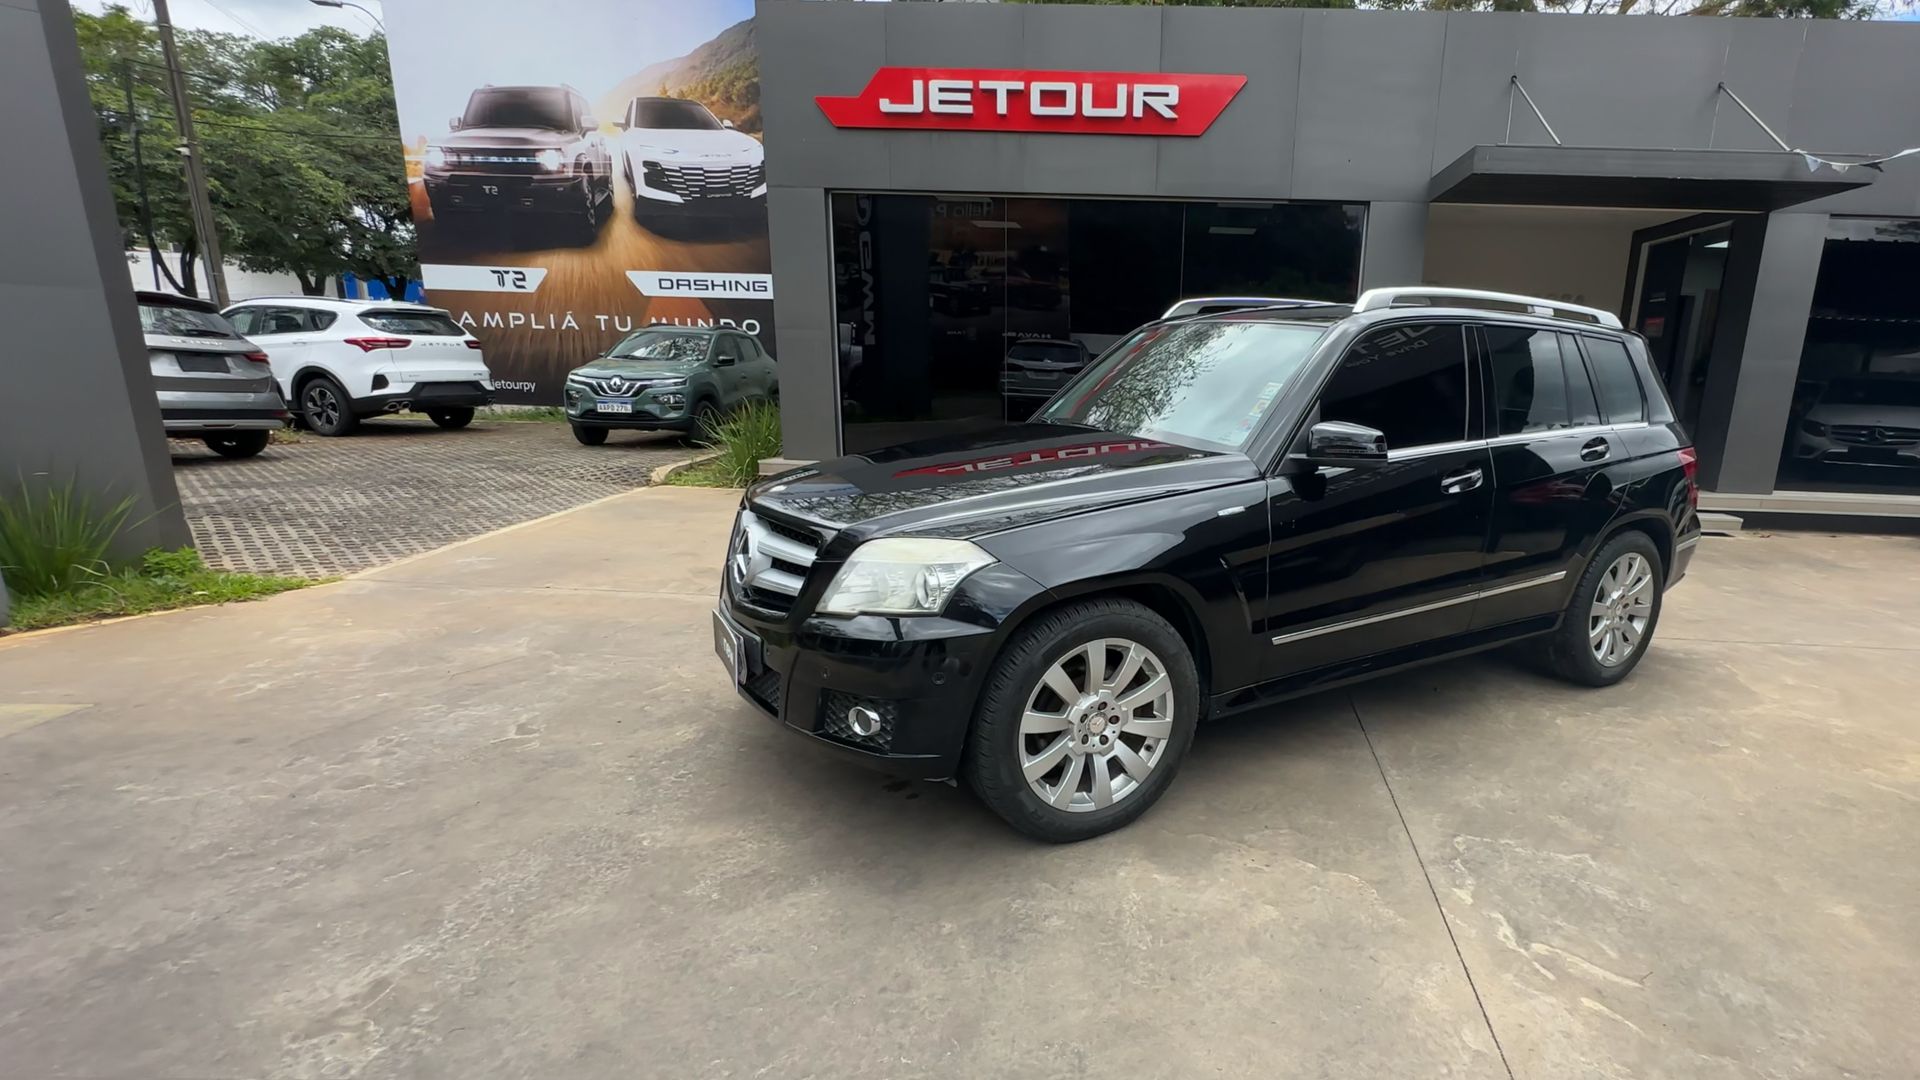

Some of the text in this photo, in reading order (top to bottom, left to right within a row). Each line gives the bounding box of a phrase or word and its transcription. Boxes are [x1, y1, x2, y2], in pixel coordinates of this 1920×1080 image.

[878, 79, 1180, 120] JETOUR
[483, 185, 499, 195] T2
[490, 269, 528, 289] T2
[658, 277, 769, 292] DASHING
[459, 311, 579, 330] AMPLIÁ
[595, 315, 632, 332] TU
